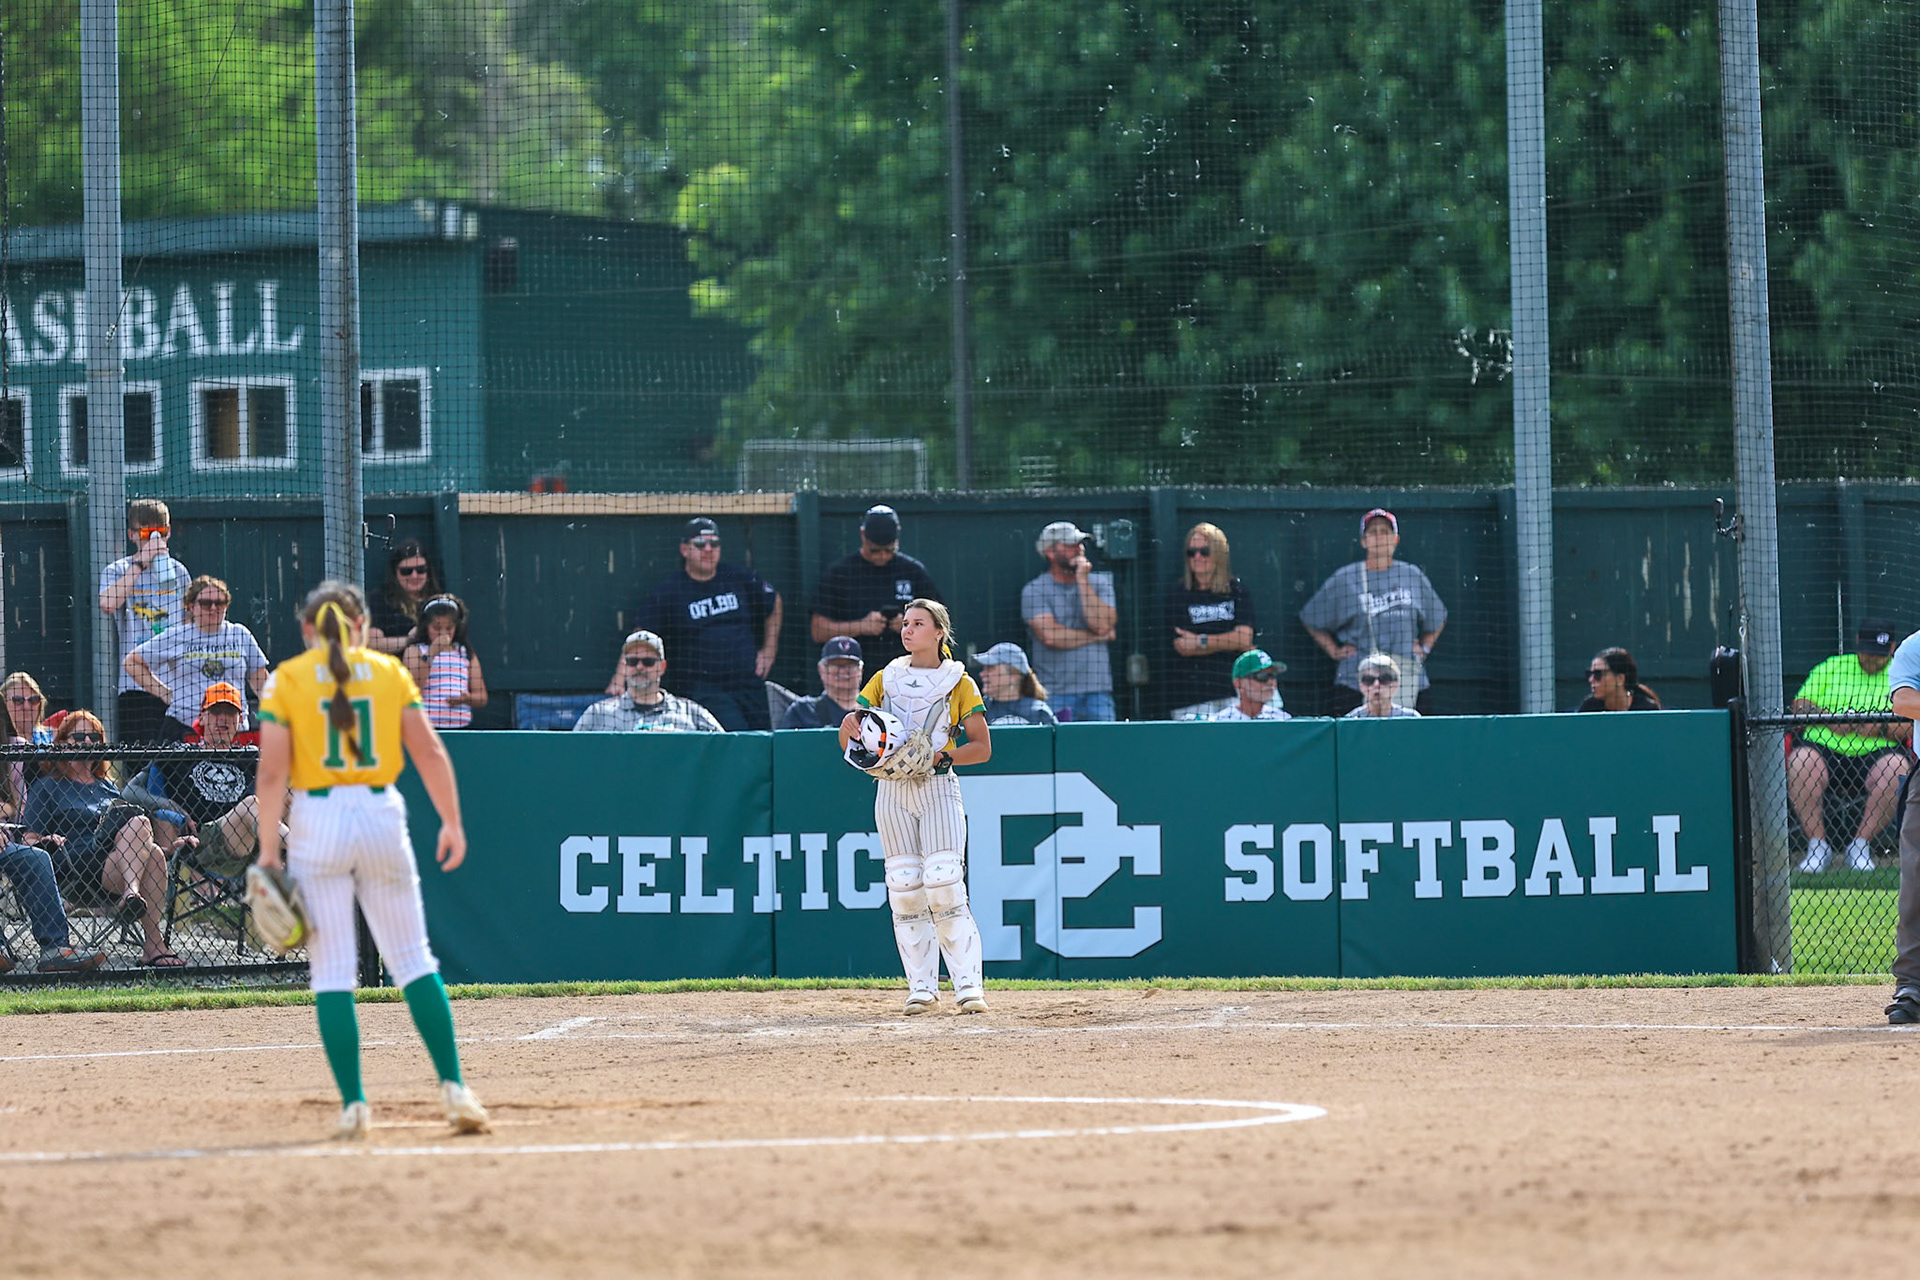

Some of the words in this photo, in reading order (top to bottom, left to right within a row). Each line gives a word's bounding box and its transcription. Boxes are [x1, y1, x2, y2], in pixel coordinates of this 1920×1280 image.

[319, 695, 380, 771] 11
[559, 831, 888, 914] CELTIC
[1224, 814, 1710, 902] SOFTBALL
